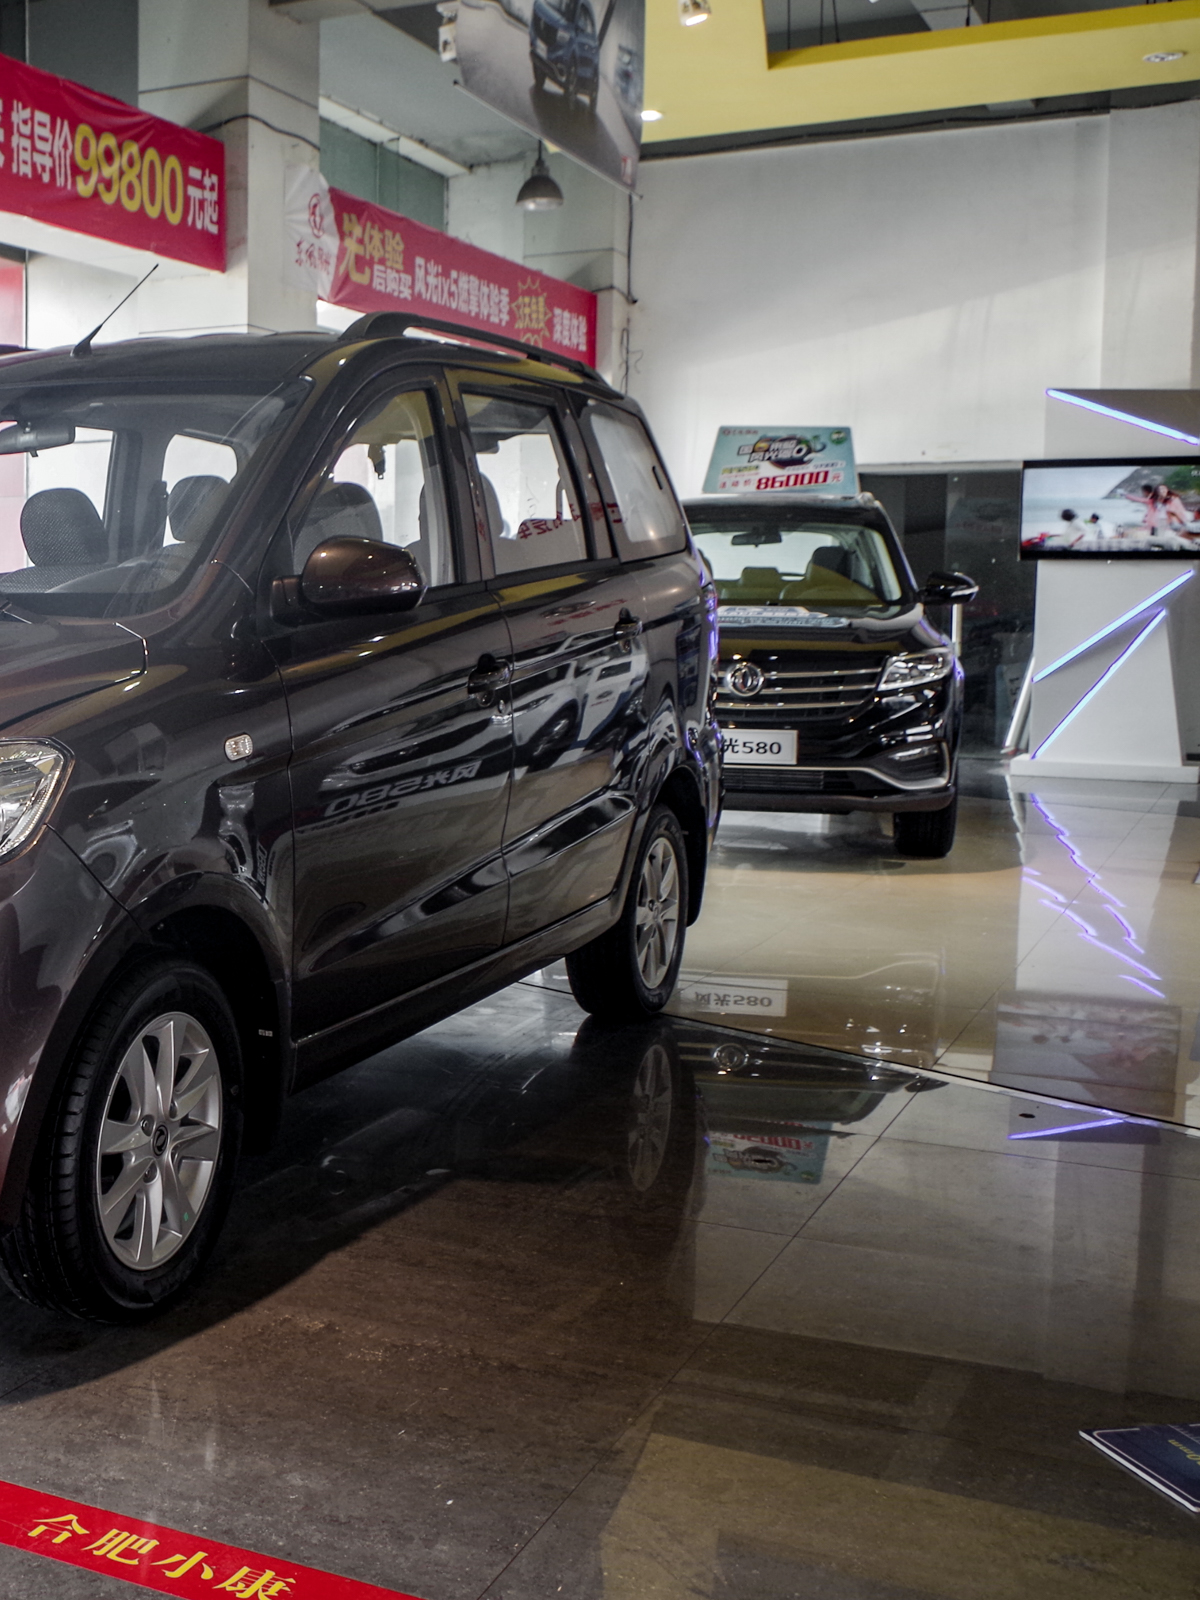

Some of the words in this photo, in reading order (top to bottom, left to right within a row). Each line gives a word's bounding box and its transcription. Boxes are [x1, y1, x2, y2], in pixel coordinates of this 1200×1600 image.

[10, 99, 220, 235] 指导价99800元起
[372, 264, 413, 300] 后购买
[27, 1513, 297, 1600] 合肥小康
